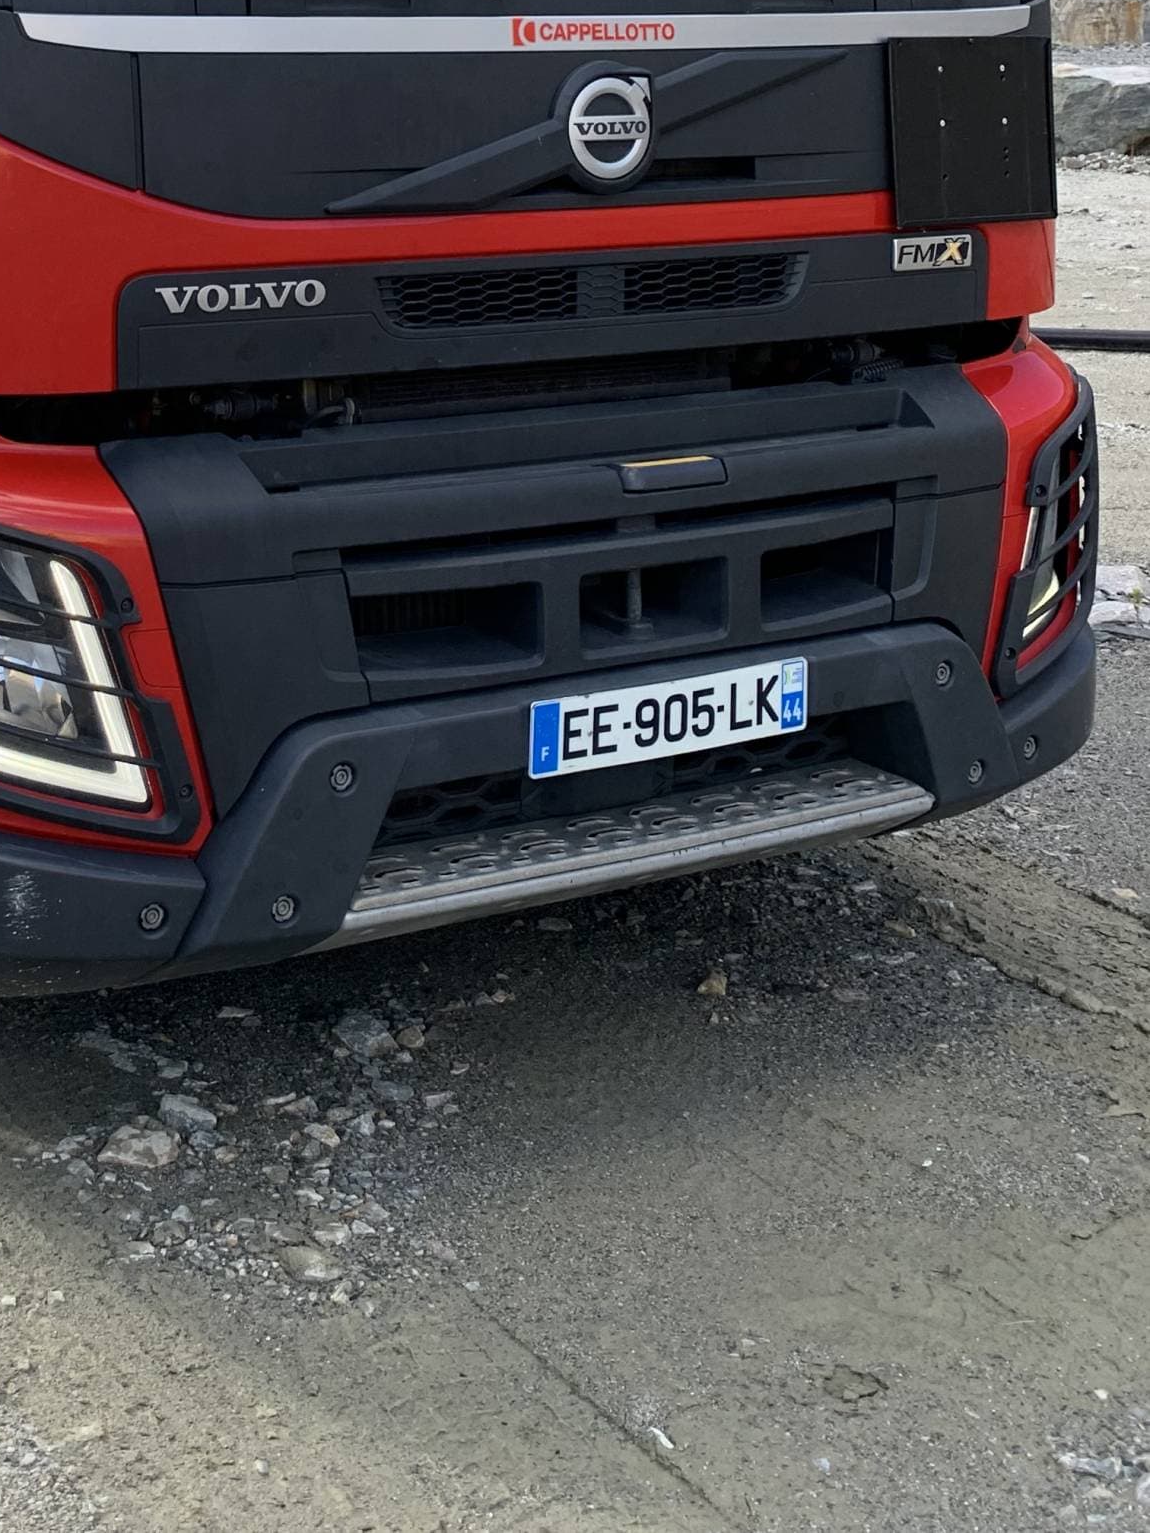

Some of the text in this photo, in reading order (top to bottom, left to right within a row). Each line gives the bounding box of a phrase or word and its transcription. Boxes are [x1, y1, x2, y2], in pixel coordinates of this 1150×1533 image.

[539, 23, 676, 41] CAPPELLOTTO
[573, 121, 647, 136] VOLVO
[898, 237, 968, 266] FMX
[155, 279, 327, 314] VOLVO
[562, 674, 780, 761] EE-905-LK
[783, 697, 802, 723] 44
[541, 745, 550, 762] F
